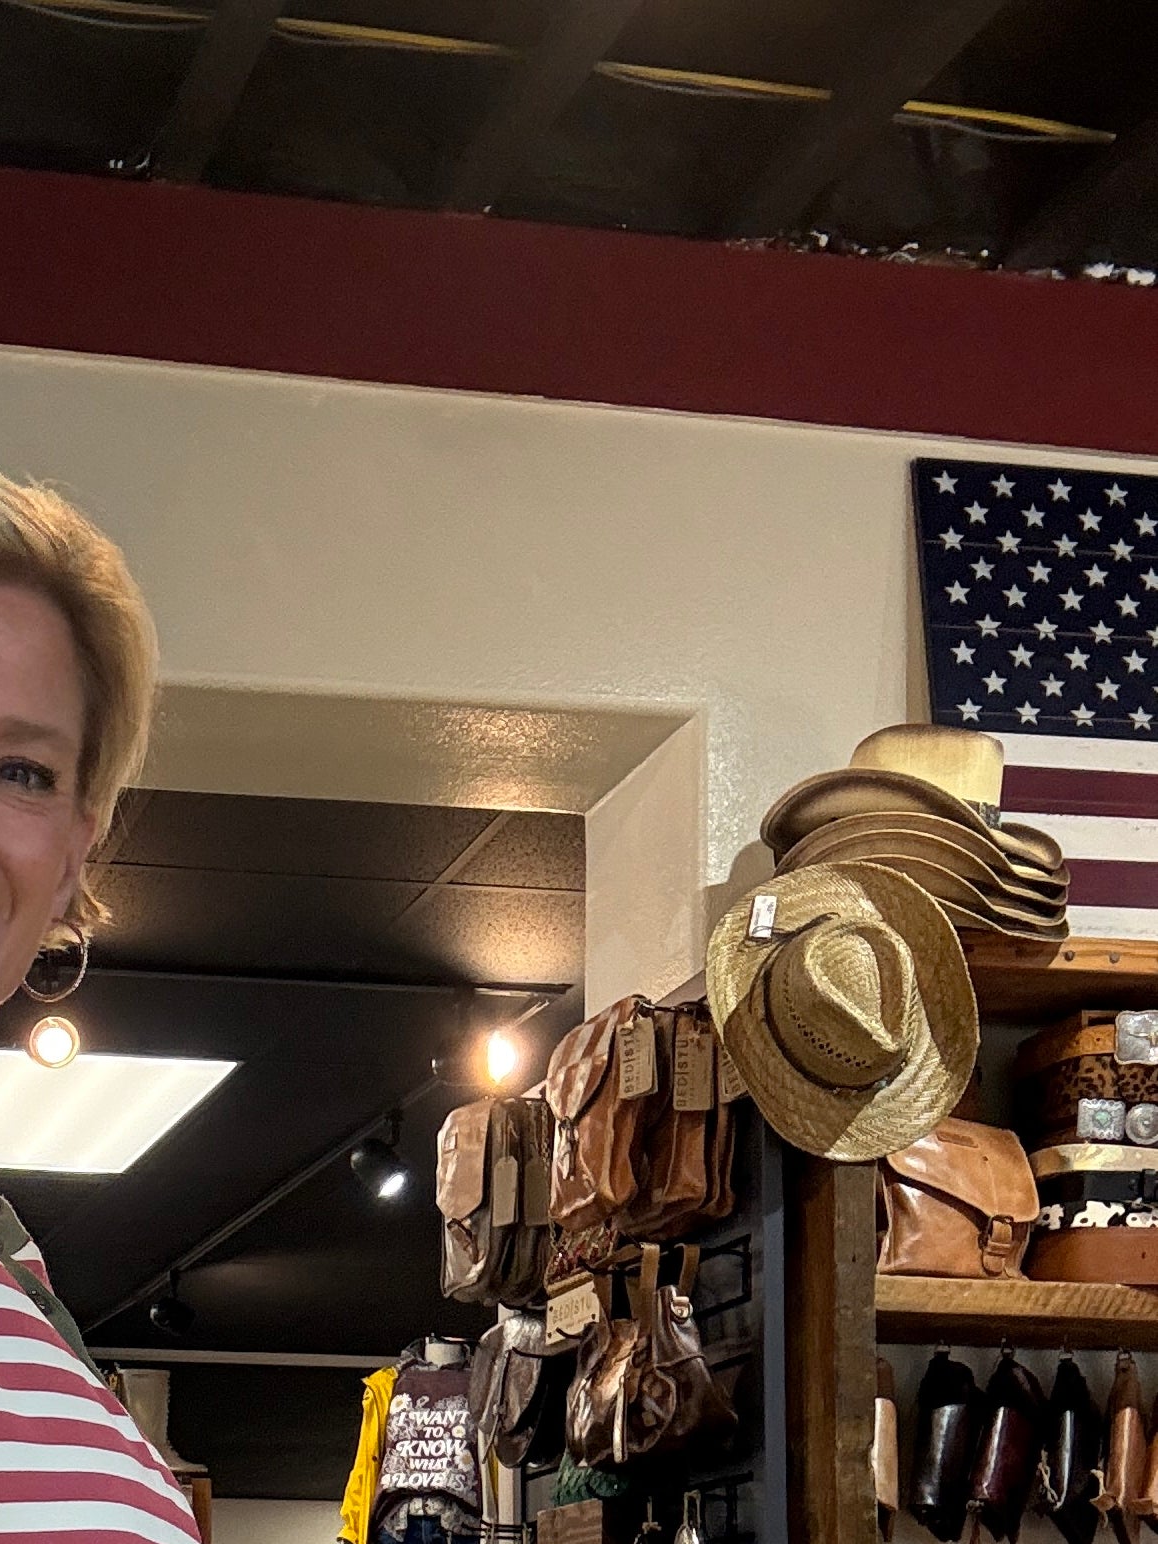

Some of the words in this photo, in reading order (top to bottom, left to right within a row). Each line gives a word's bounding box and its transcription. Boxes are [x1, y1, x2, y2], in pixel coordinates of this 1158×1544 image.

[407, 1410, 470, 1426] WANT
[423, 1427, 444, 1438] TO
[395, 1439, 468, 1457] KNOW
[409, 1457, 451, 1471] WHAT
[391, 1472, 446, 1489] LOVE
